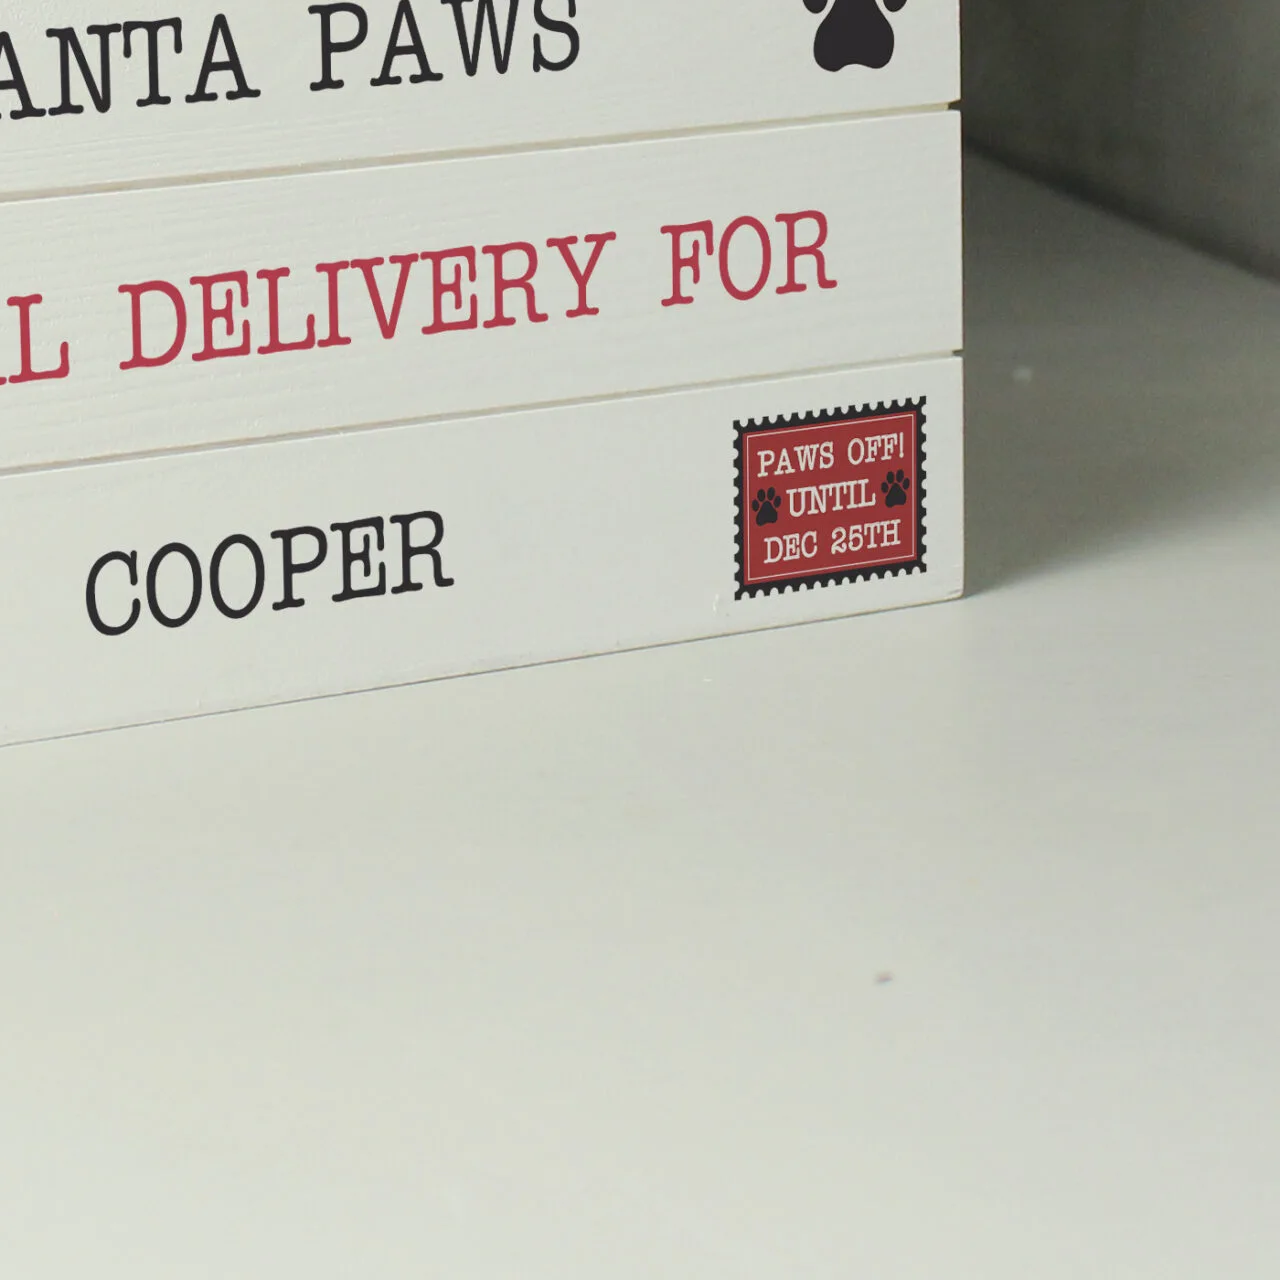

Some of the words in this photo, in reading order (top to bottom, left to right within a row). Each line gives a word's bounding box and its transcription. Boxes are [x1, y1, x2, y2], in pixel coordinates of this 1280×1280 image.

[118, 231, 617, 371] DELIVERY
[661, 209, 838, 307] FOR
[757, 441, 835, 477] PAWS
[847, 432, 904, 465] OFF!
[786, 478, 876, 517] UNTIL
[764, 531, 818, 564] DEC
[831, 519, 901, 555] 25TH
[86, 510, 454, 636] COOPER
